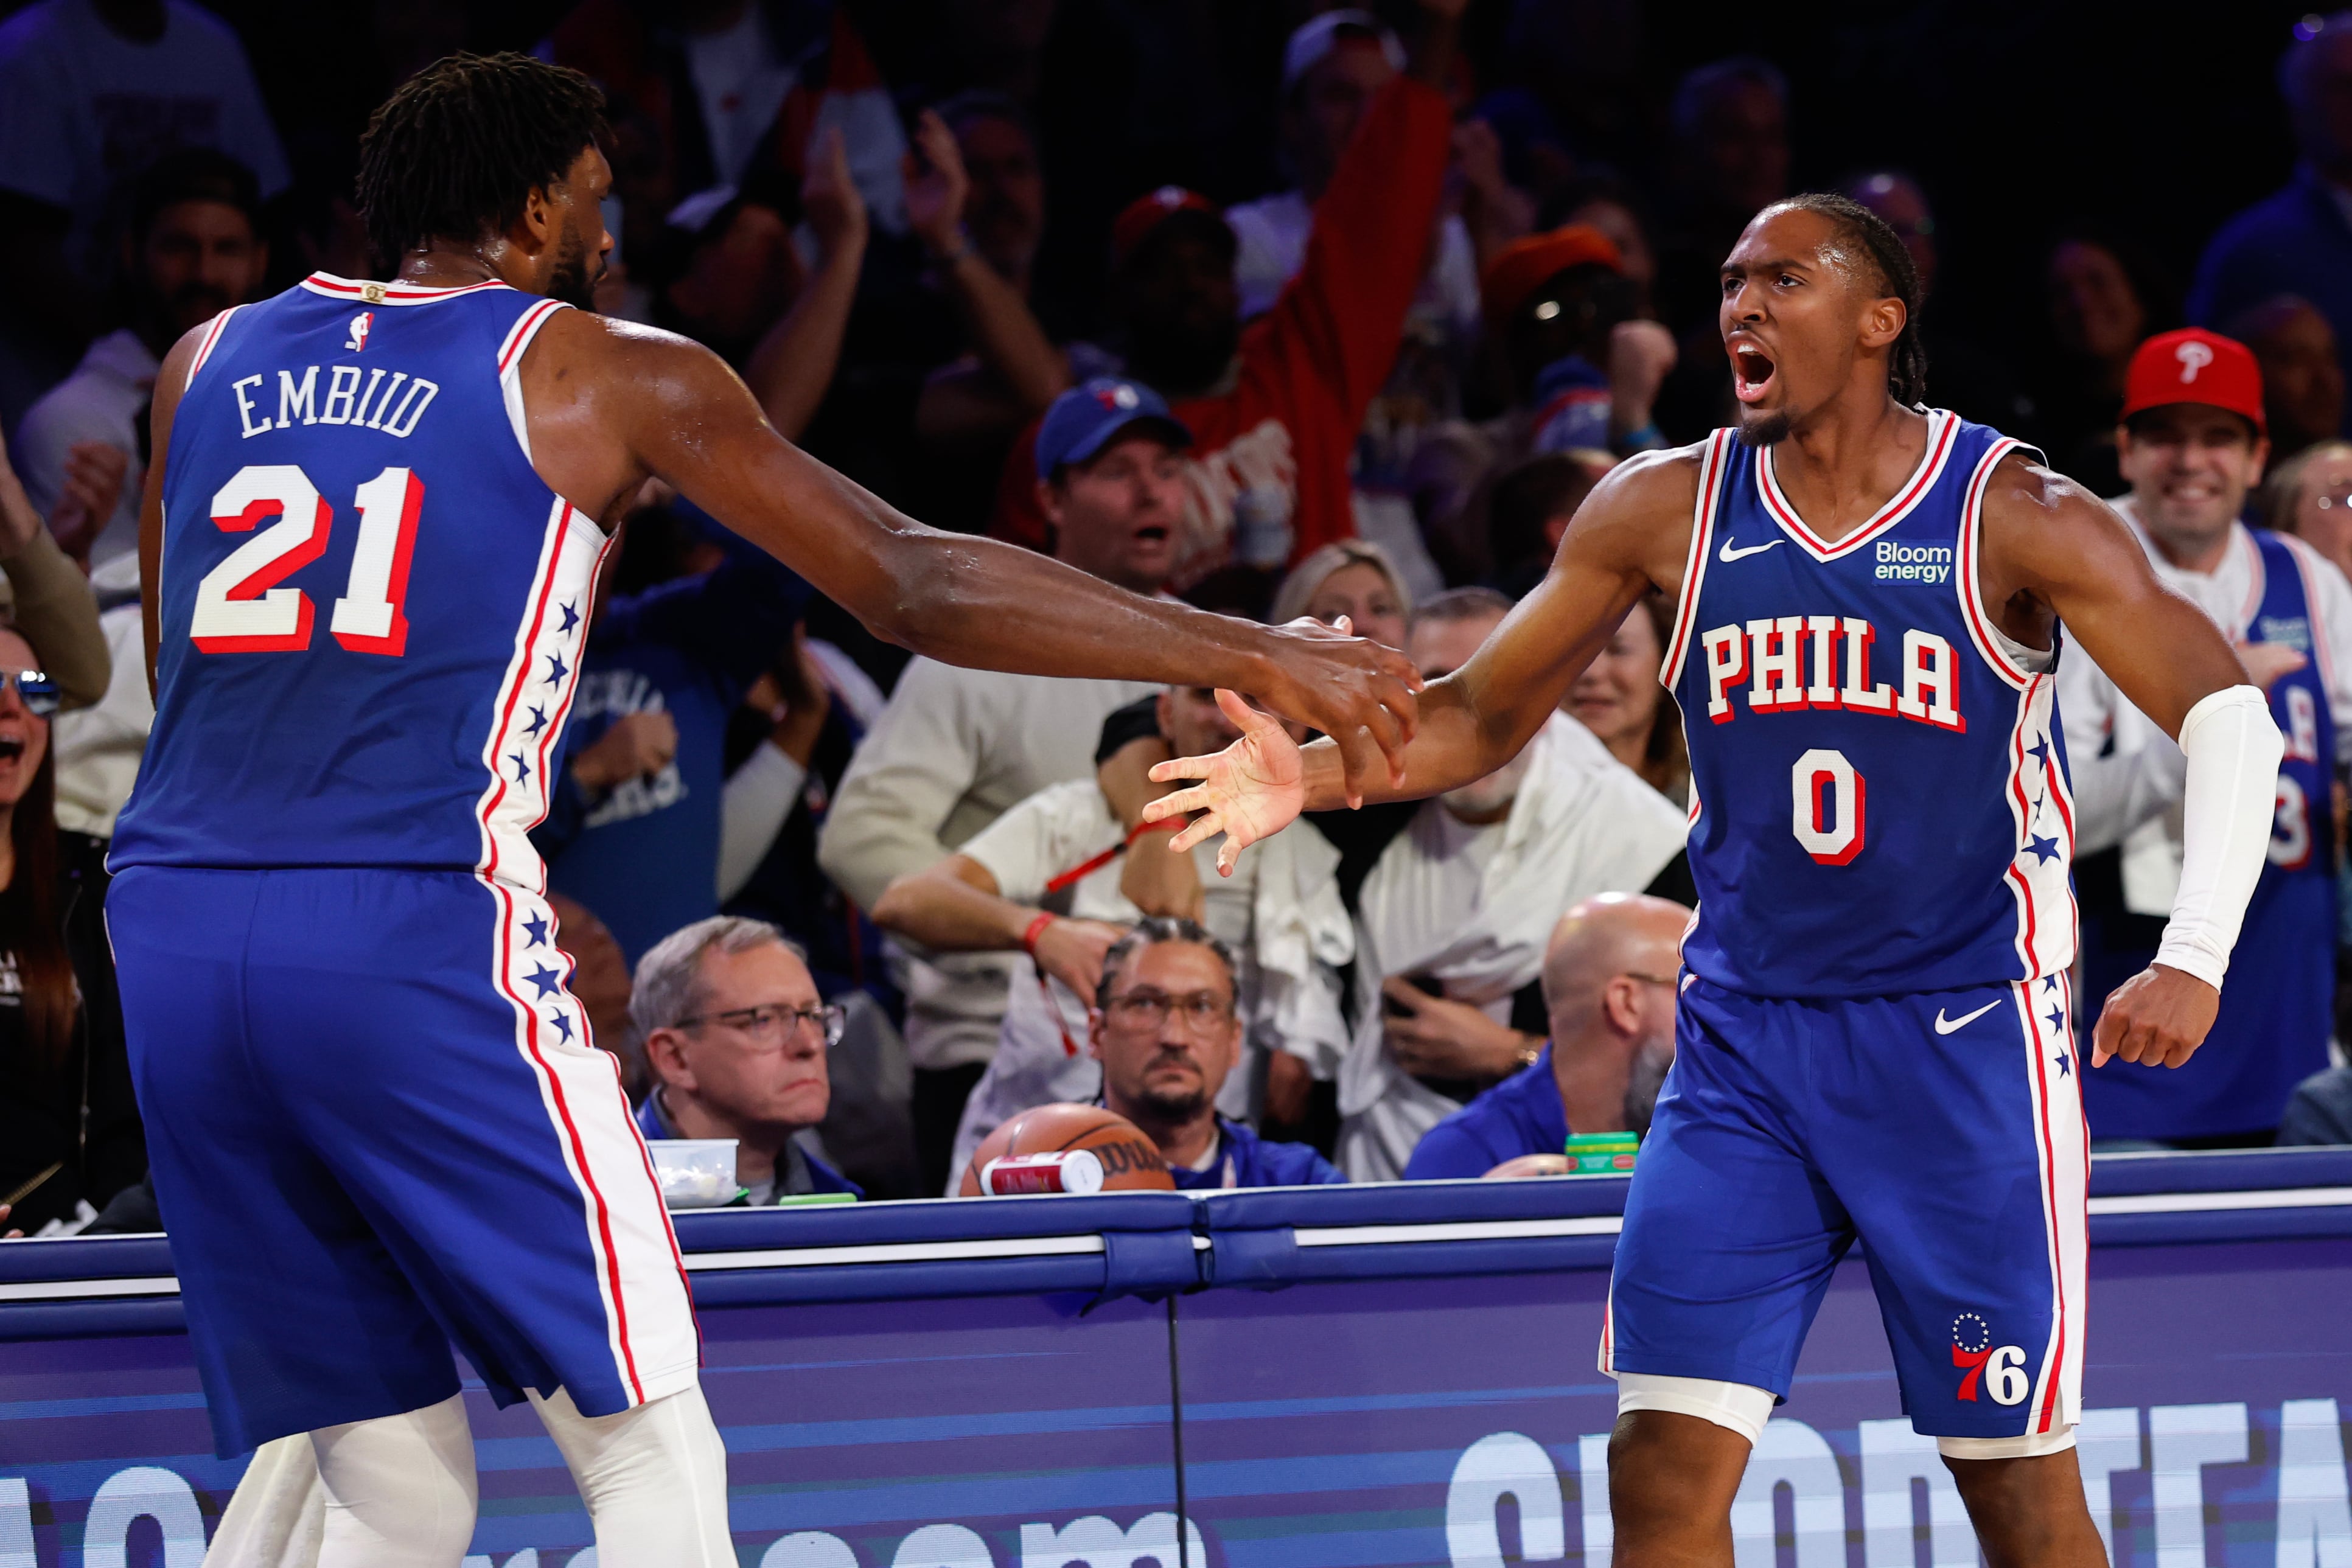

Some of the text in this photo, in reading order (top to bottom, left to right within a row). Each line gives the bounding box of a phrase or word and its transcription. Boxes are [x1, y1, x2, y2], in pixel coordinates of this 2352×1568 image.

[232, 365, 439, 438] EMBIID
[189, 464, 425, 657] 21
[1875, 565, 1950, 583] energy
[1876, 542, 1952, 563] Bloom
[1701, 615, 1966, 734] PHILA
[1792, 748, 1866, 866] 0
[1952, 1343, 2029, 1406] 76
